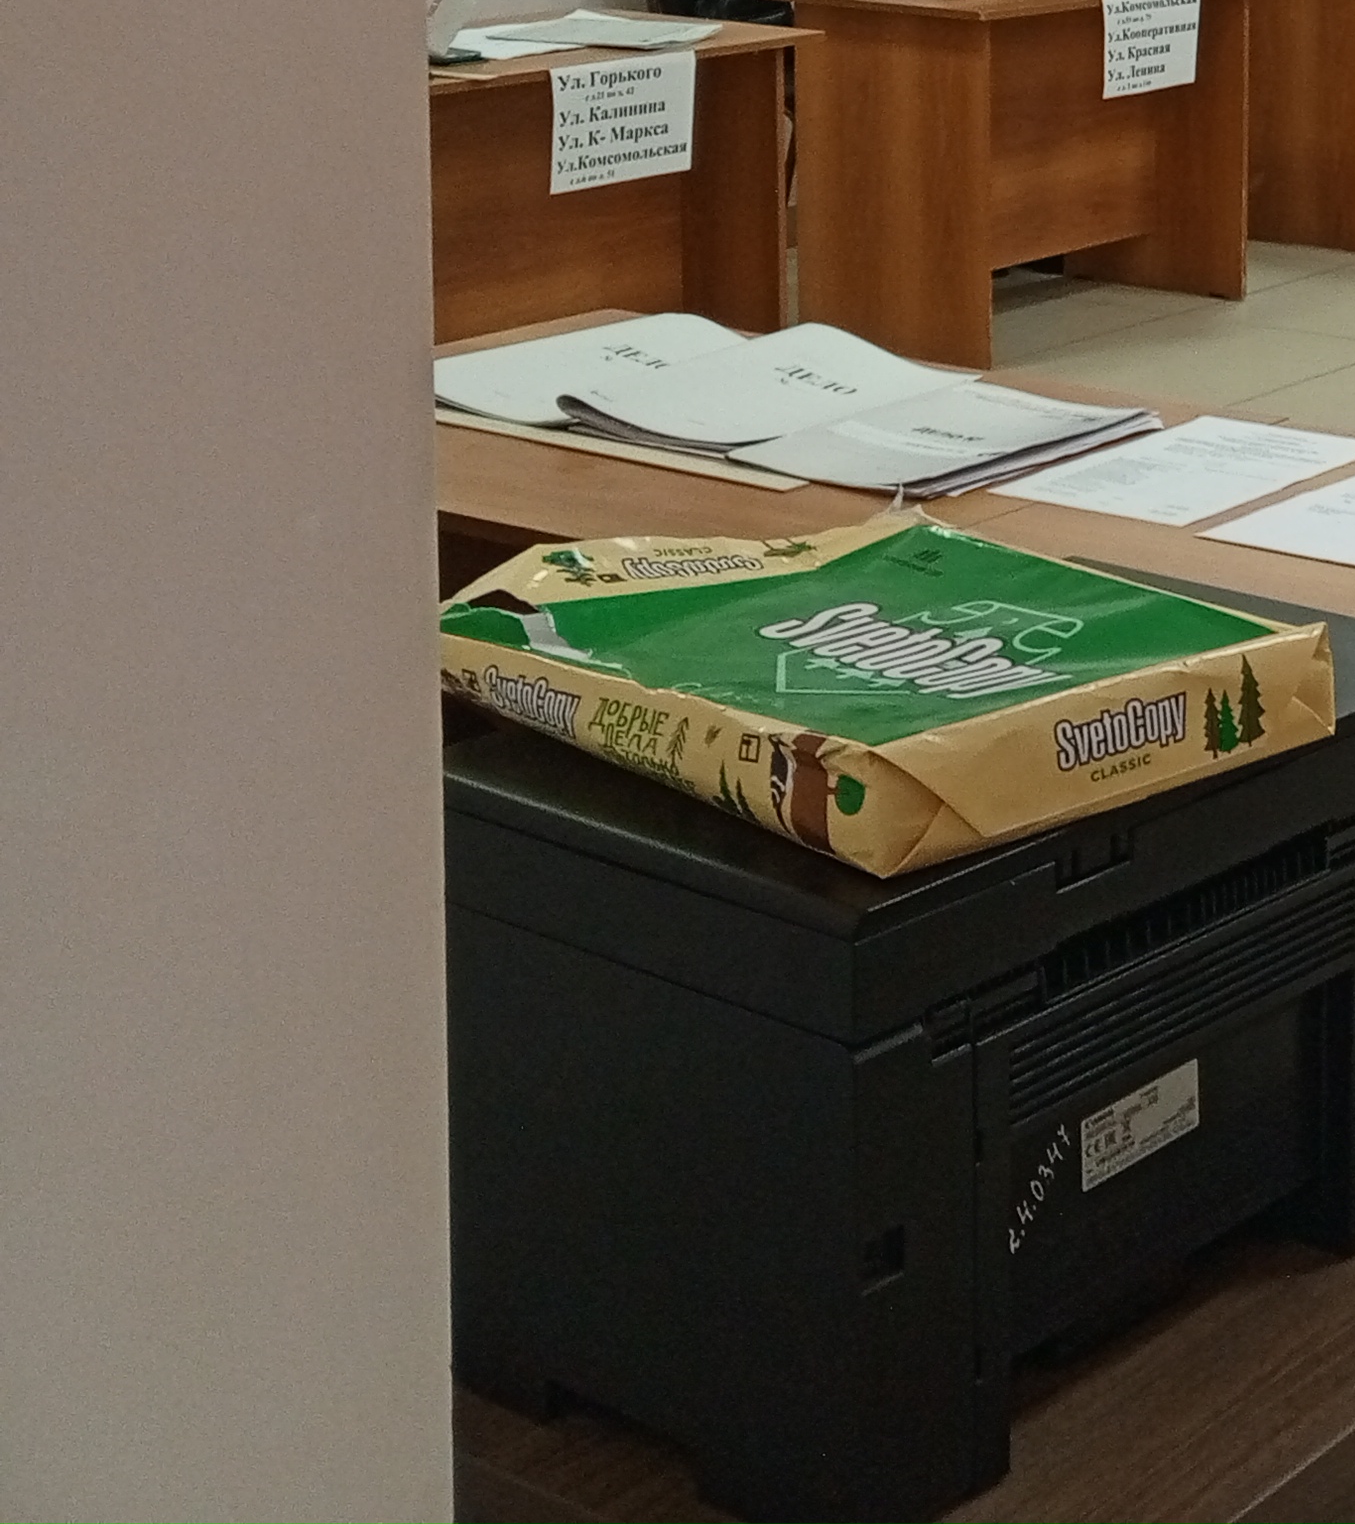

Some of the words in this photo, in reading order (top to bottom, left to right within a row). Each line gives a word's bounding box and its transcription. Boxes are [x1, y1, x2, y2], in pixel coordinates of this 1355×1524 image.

[1127, 43, 1171, 61] Красная
[558, 75, 586, 92] Ул.
[589, 67, 662, 89] Горького
[559, 110, 585, 128] Ул.
[589, 100, 666, 123] Калинина
[558, 134, 584, 151] Ул.
[610, 123, 669, 143] Маркса
[774, 363, 858, 395] ДЕЛО
[758, 602, 1073, 700] SvetoCopy
[483, 664, 582, 740] SvetoCopy
[589, 696, 669, 738] ДОБРЫЕ
[600, 724, 658, 757] ДЕЛА
[1054, 691, 1187, 772] SvetoCopy
[1090, 754, 1152, 783] CLASSIC
